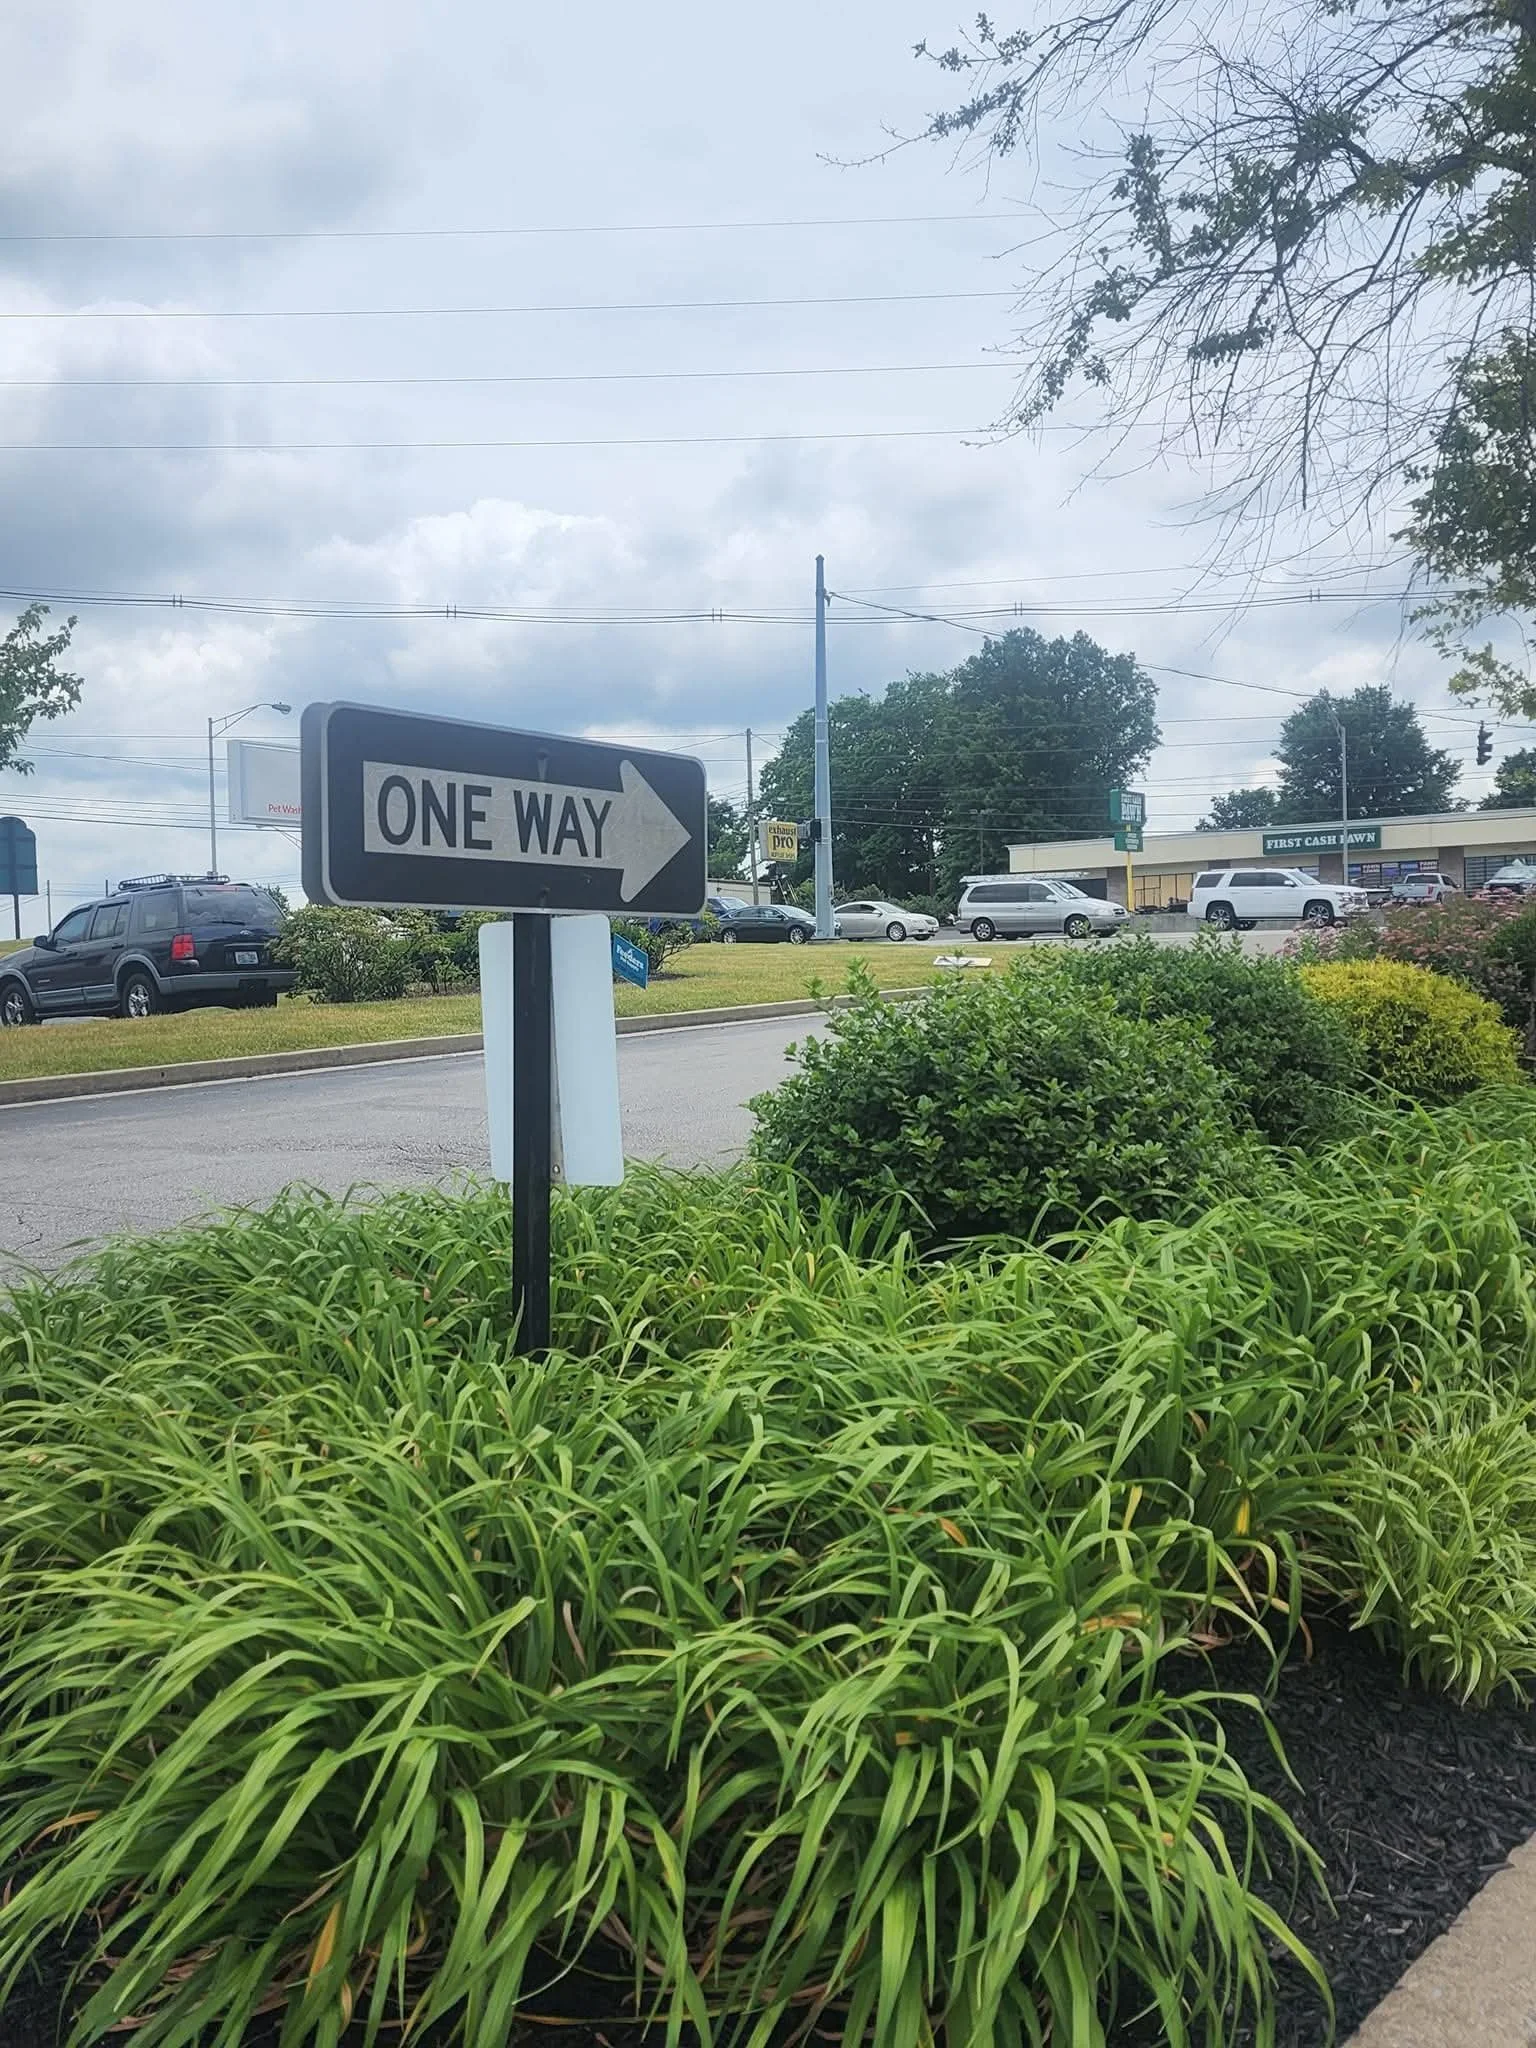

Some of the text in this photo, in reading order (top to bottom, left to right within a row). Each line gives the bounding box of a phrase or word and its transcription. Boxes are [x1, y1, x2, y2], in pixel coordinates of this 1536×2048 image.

[268, 803, 281, 813] Pet
[377, 774, 612, 858] ONE WAY
[768, 825, 797, 835] exhaust
[773, 835, 794, 850] pro
[1266, 837, 1302, 849] FIRST
[1304, 835, 1337, 847] CASH
